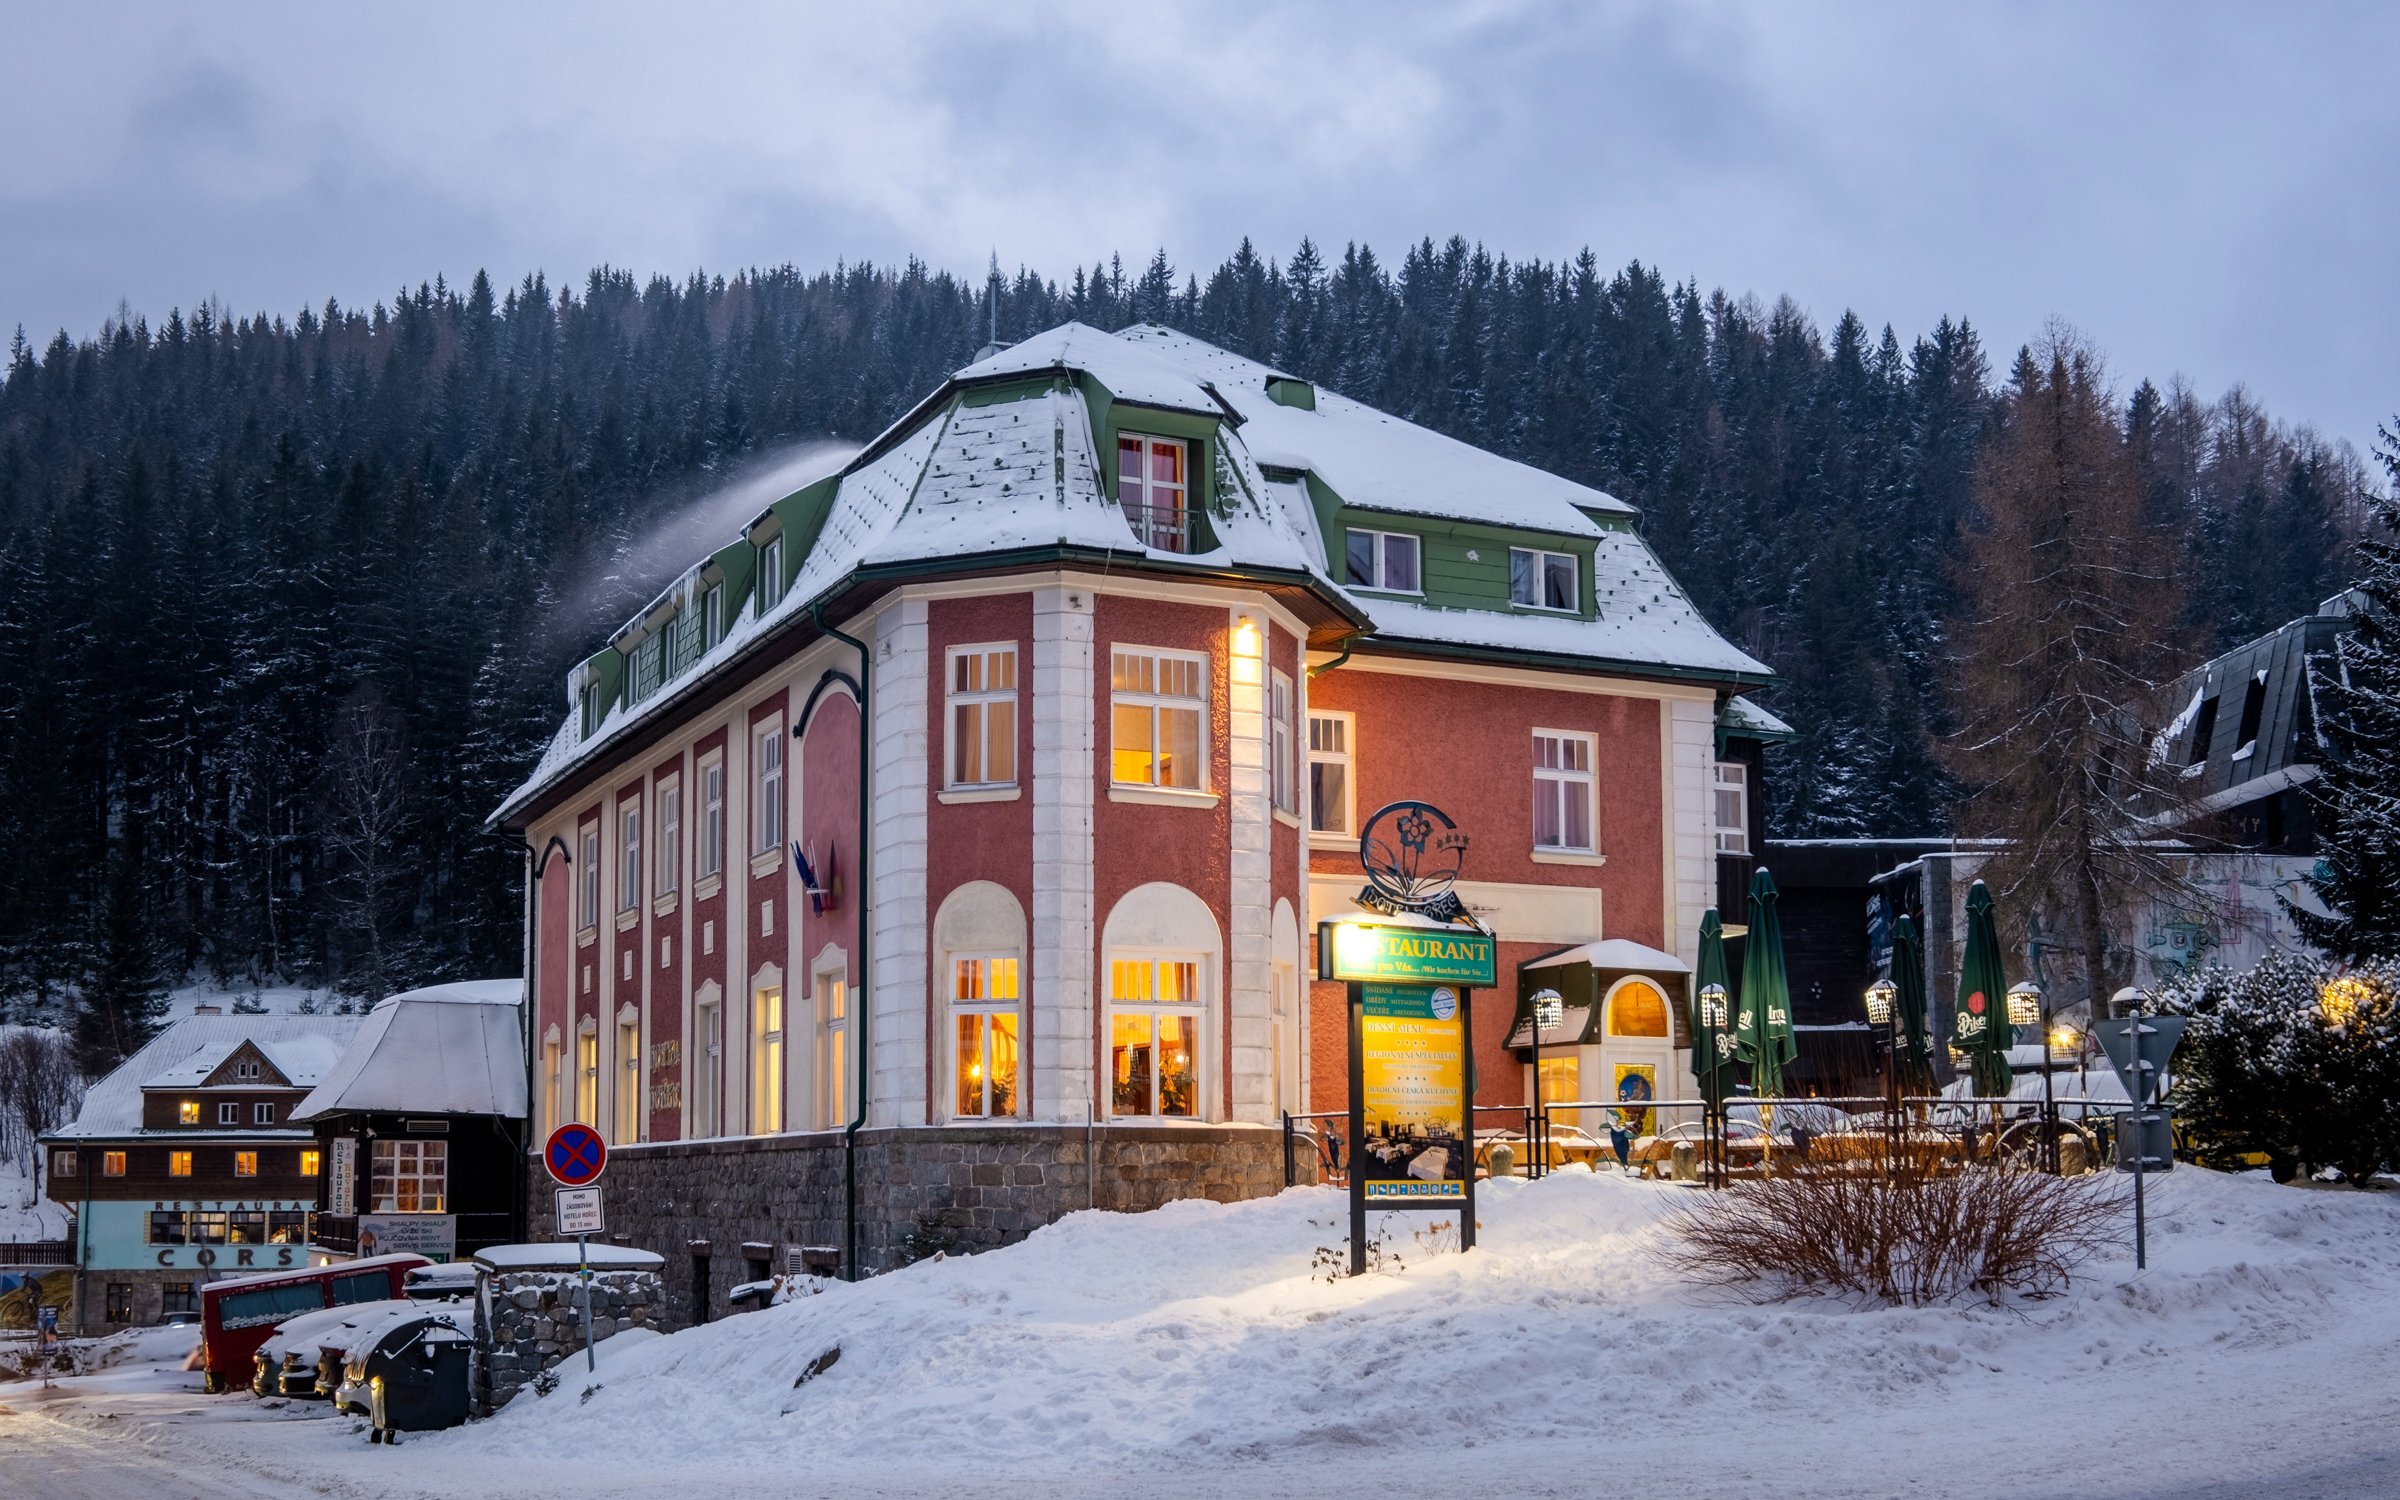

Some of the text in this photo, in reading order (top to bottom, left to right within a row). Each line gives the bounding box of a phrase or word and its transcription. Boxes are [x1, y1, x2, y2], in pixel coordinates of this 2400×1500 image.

[1372, 937, 1489, 961] STAURANT
[1437, 965, 1460, 975] kochen
[1460, 967, 1470, 976] für
[157, 1248, 293, 1267] CORS
